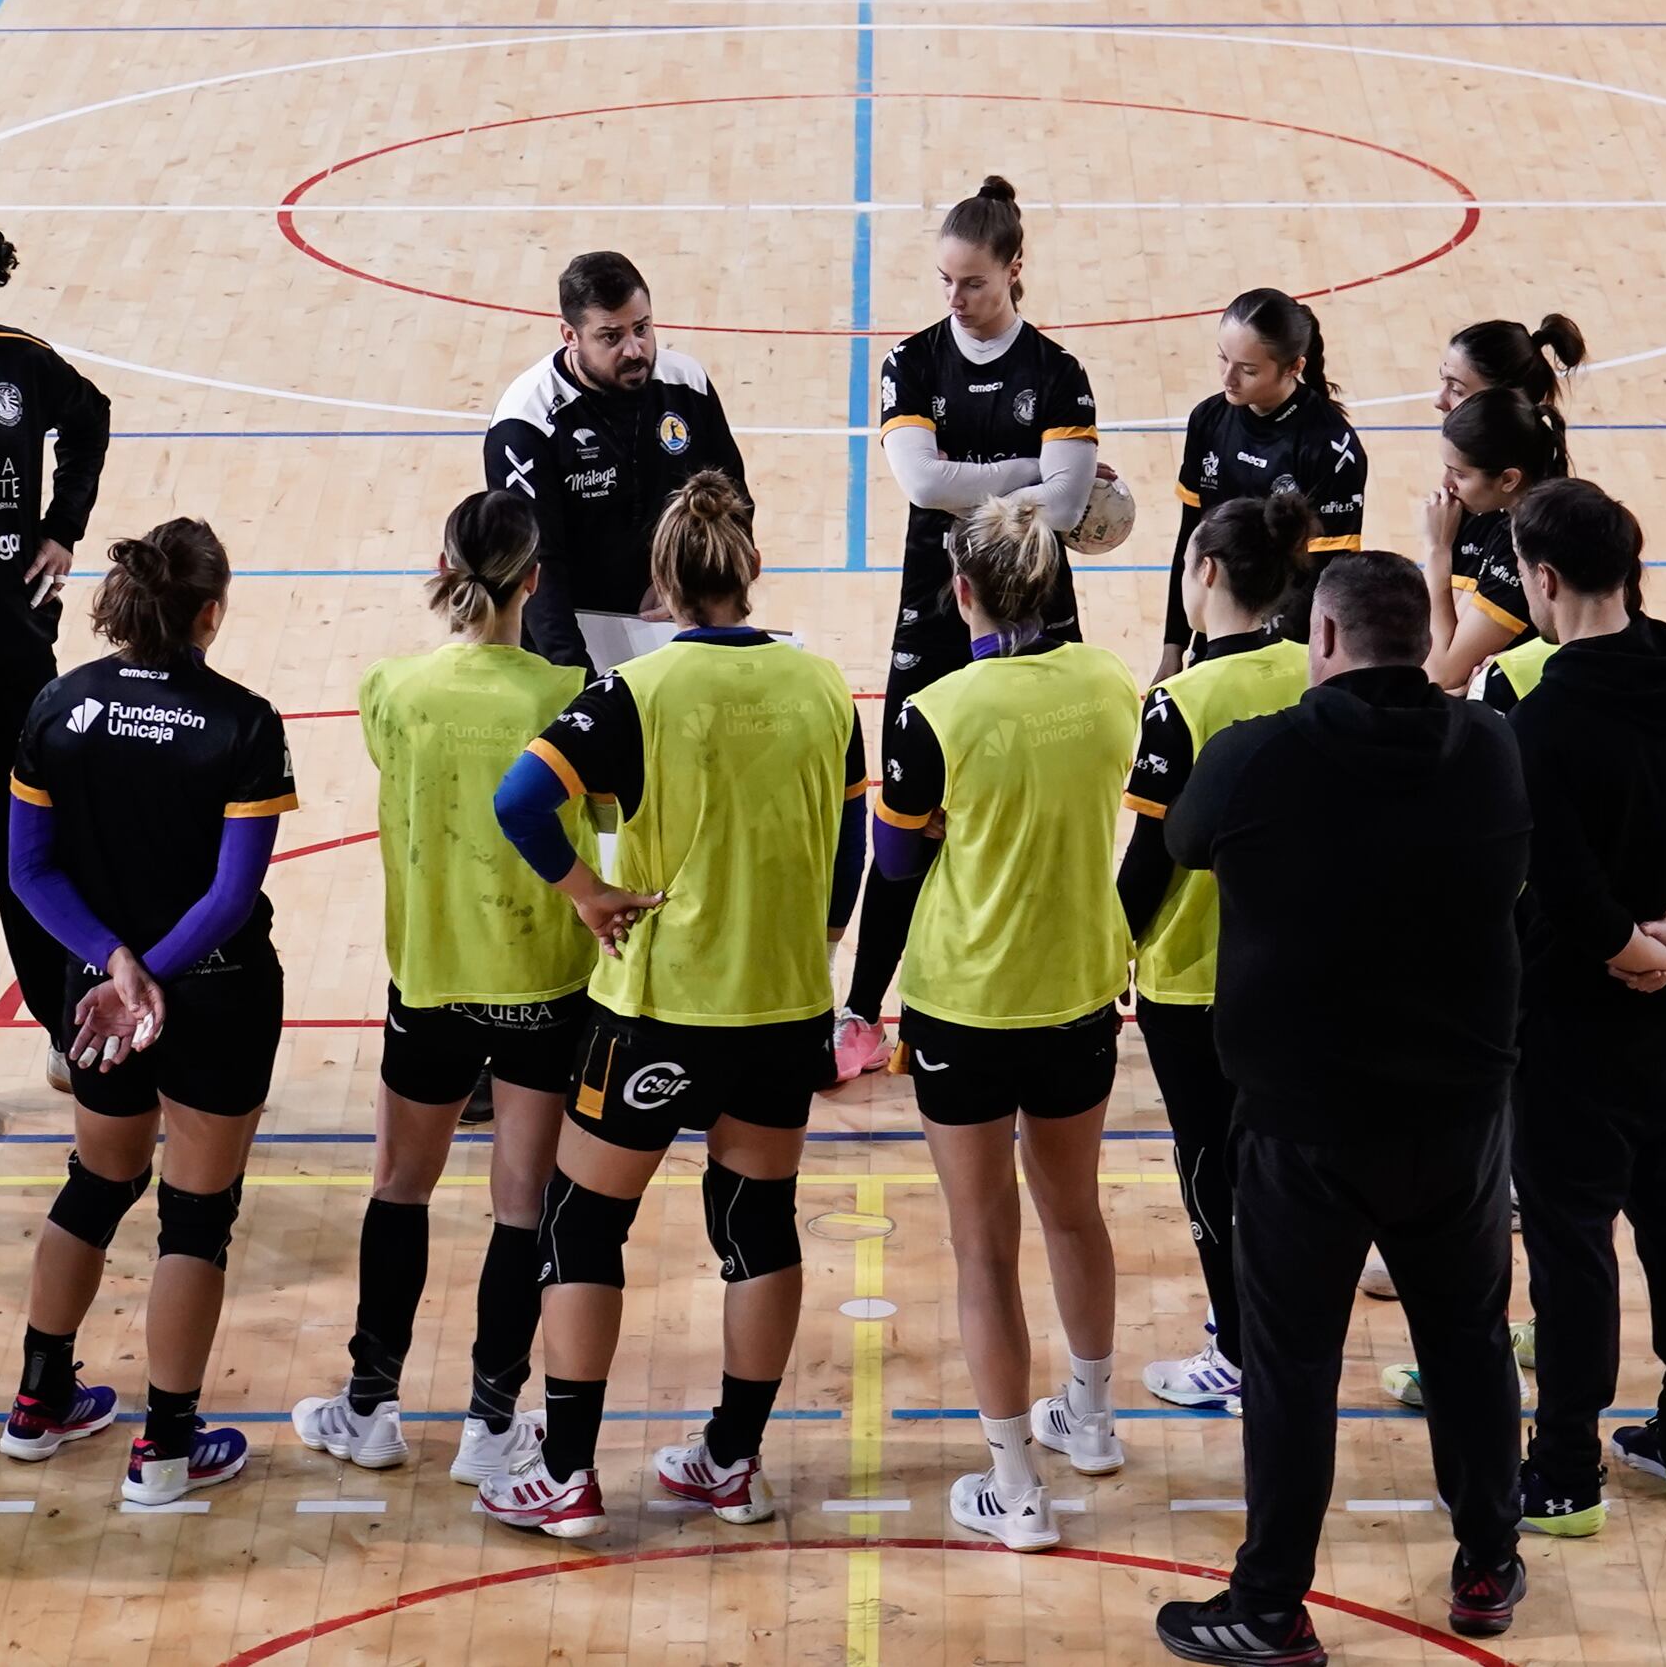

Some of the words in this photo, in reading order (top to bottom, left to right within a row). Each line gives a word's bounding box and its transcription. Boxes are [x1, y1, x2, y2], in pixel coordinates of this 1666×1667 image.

[565, 466, 617, 491] Málaga
[109, 701, 206, 729] Fundación
[108, 719, 174, 744] Unicaja
[637, 1075, 692, 1096] CSIF
